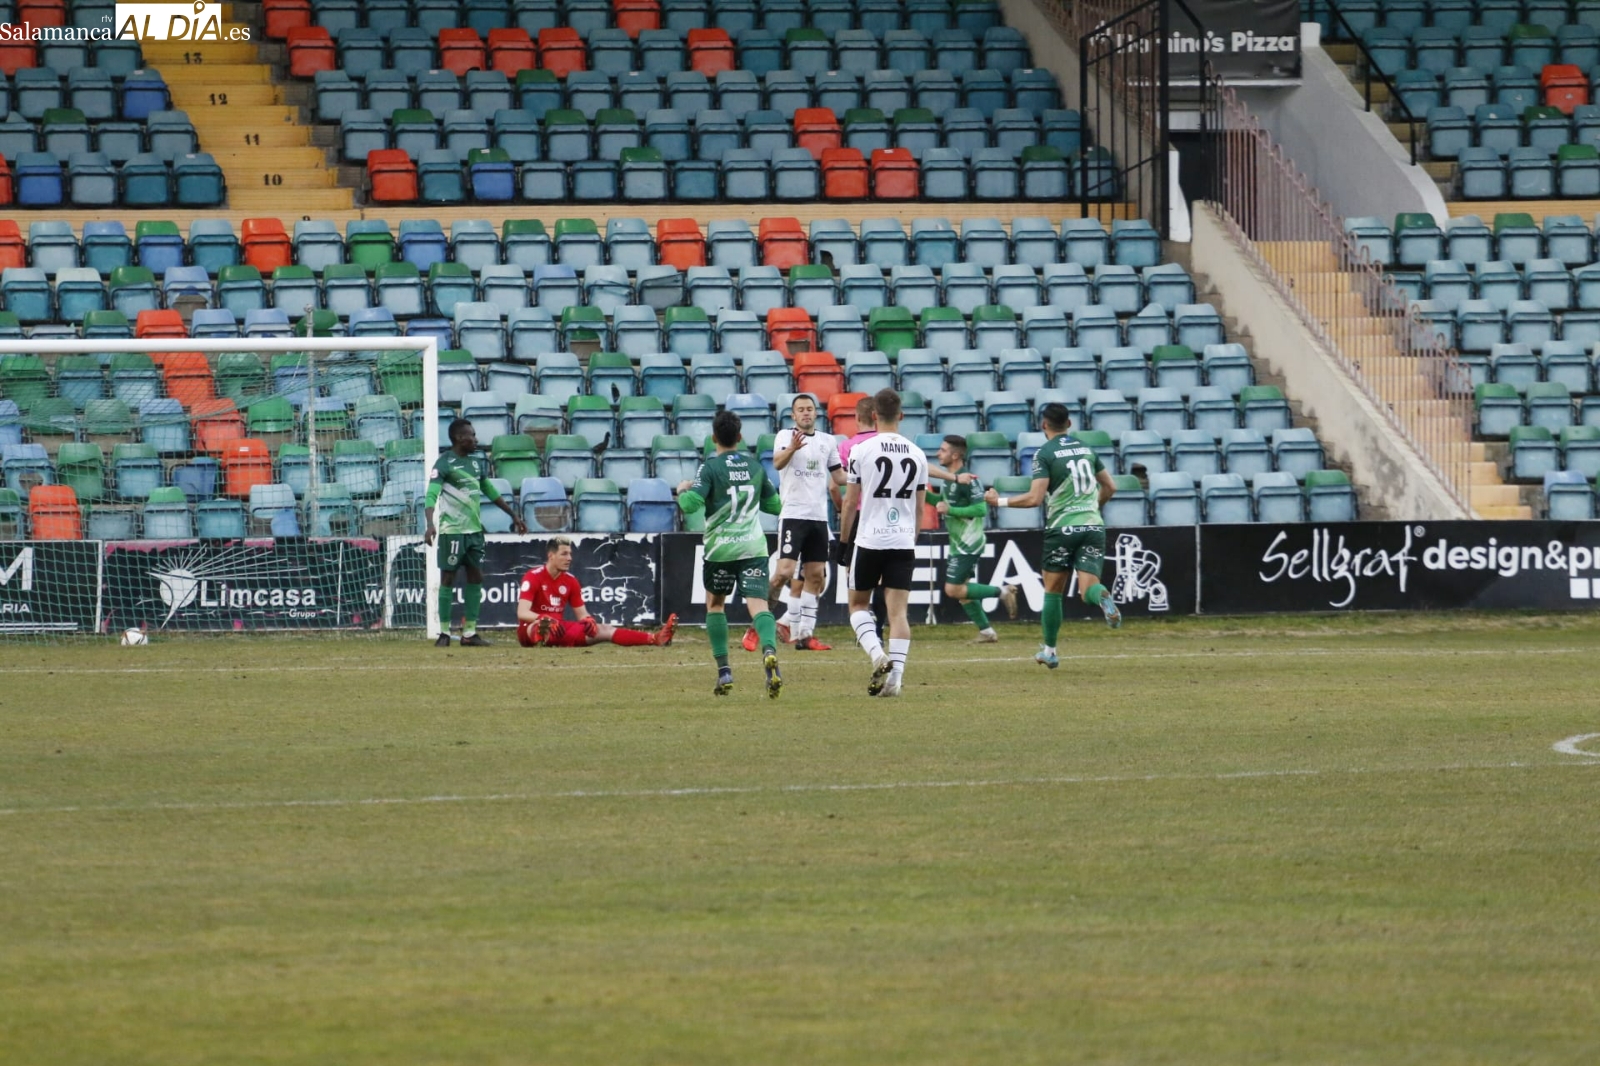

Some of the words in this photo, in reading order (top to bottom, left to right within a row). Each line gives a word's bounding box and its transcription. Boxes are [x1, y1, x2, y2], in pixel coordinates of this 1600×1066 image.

[1231, 30, 1295, 53] Pizza
[209, 93, 228, 106] 12
[244, 133, 260, 146] 11
[263, 173, 283, 186] 10
[881, 442, 910, 454] MANIN
[873, 455, 918, 499] 22
[1066, 458, 1097, 497] 10
[726, 484, 755, 524] 17
[785, 530, 792, 543] 3
[450, 540, 460, 554] 11
[200, 580, 317, 607] Limcasa
[288, 608, 317, 619] Grupo
